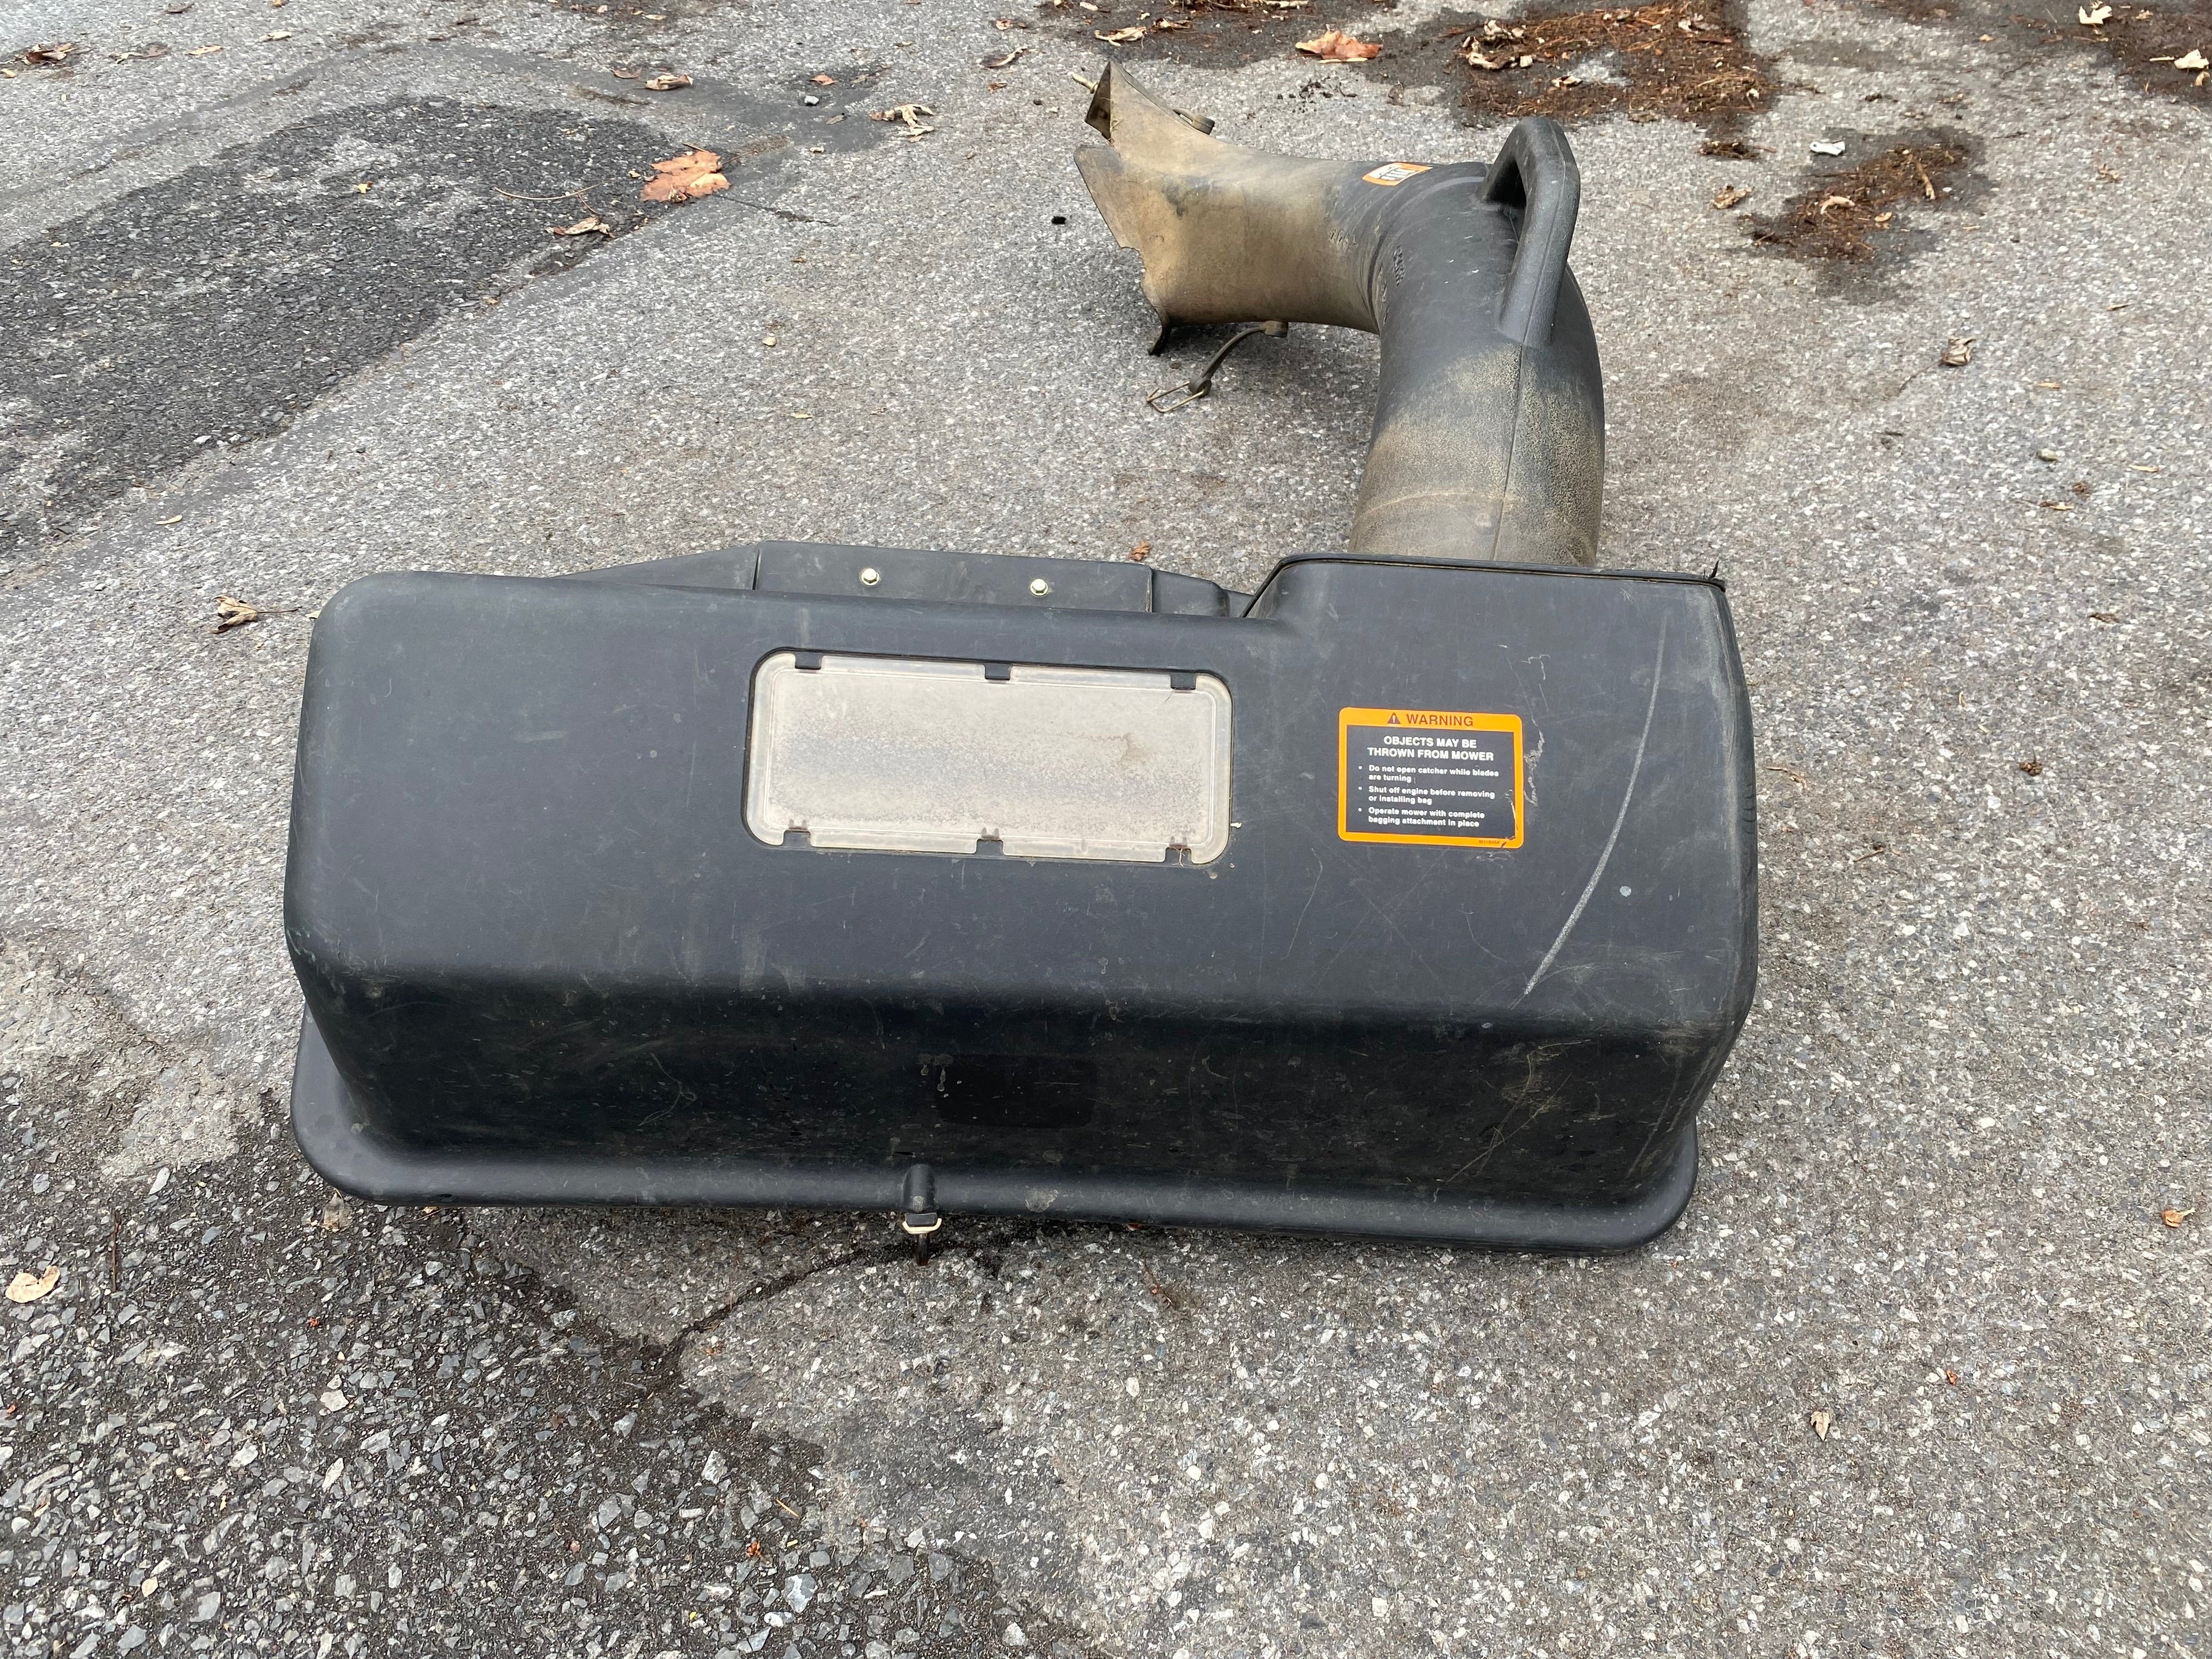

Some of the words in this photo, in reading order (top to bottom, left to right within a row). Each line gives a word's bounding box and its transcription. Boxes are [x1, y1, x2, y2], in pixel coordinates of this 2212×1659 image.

[1407, 714, 1473, 726] WARNING
[1384, 736, 1433, 747] OBJECTS
[1436, 738, 1459, 748] MAY
[1461, 739, 1477, 748] BE
[1367, 748, 1414, 758] THROWN
[1418, 749, 1448, 759] FROM
[1452, 751, 1494, 761] MOWER
[1396, 767, 1415, 775] open
[1383, 775, 1411, 783] turning
[1402, 788, 1428, 796] engine
[1457, 790, 1495, 799] removing
[1380, 796, 1415, 804] installing
[1418, 797, 1432, 805] bag
[1369, 807, 1399, 817] Operate
[1448, 811, 1484, 820] complete
[1369, 817, 1400, 825] bagging
[1457, 820, 1479, 828] place
